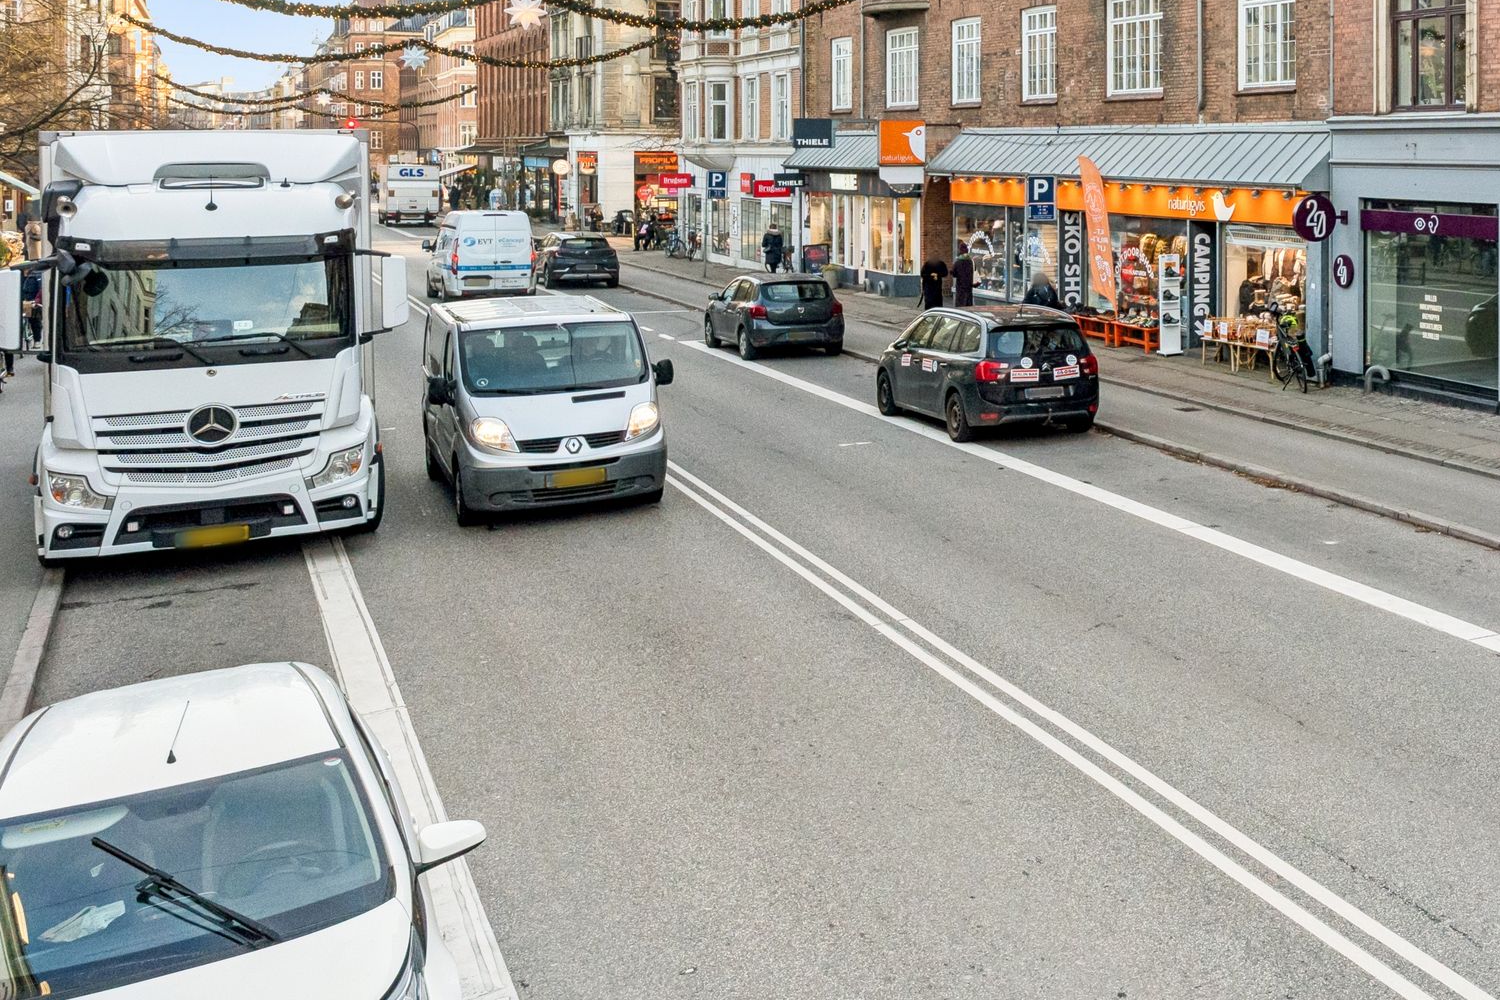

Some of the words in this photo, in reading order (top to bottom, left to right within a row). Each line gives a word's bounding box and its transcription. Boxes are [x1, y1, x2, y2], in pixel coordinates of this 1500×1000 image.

[796, 138, 829, 146] THIELE
[399, 168, 425, 177] GLS
[712, 173, 723, 187] P
[1033, 179, 1049, 200] P
[1168, 195, 1206, 216] naturligvis
[1064, 212, 1080, 307] SKO-SHO
[1193, 233, 1211, 317] CAMPING
